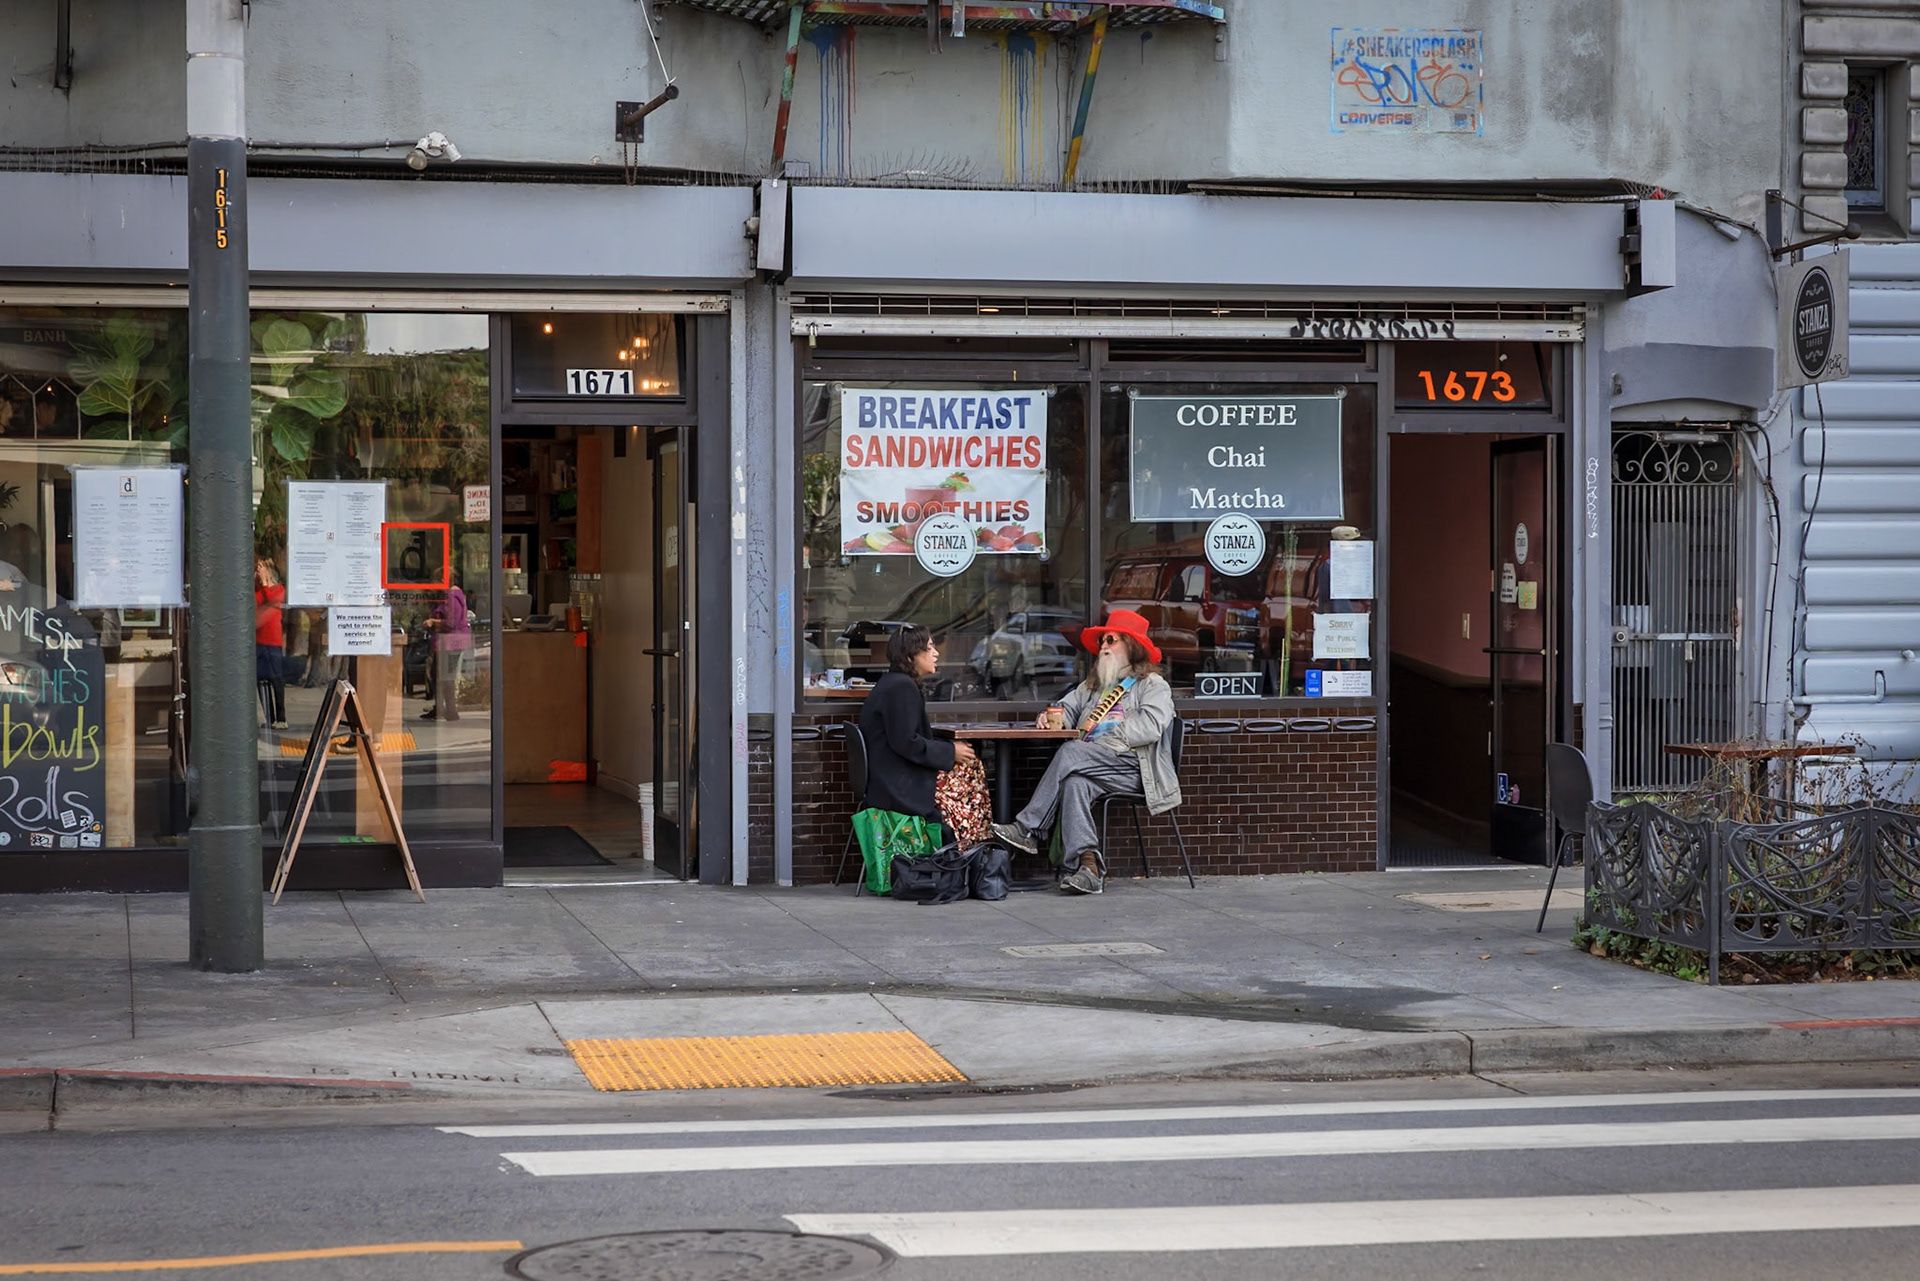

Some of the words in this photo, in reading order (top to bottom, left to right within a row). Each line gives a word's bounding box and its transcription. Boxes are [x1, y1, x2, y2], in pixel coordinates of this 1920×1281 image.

[1340, 112, 1413, 125] CONVERSE
[215, 169, 228, 249] 1615
[1799, 304, 1829, 335] STANZA
[571, 371, 629, 394] 1671
[1418, 370, 1516, 401] 1673
[859, 396, 1031, 429] BREAKFAST
[1176, 404, 1297, 426] COFFEE
[846, 435, 1041, 468] SANDWICHES
[1207, 446, 1266, 467] Chai
[1190, 487, 1285, 509] Matcha
[856, 500, 1030, 523] SMOOTHIES
[924, 536, 967, 550] STANZA
[1213, 535, 1255, 549] STANZA
[1200, 677, 1257, 695] OPEN
